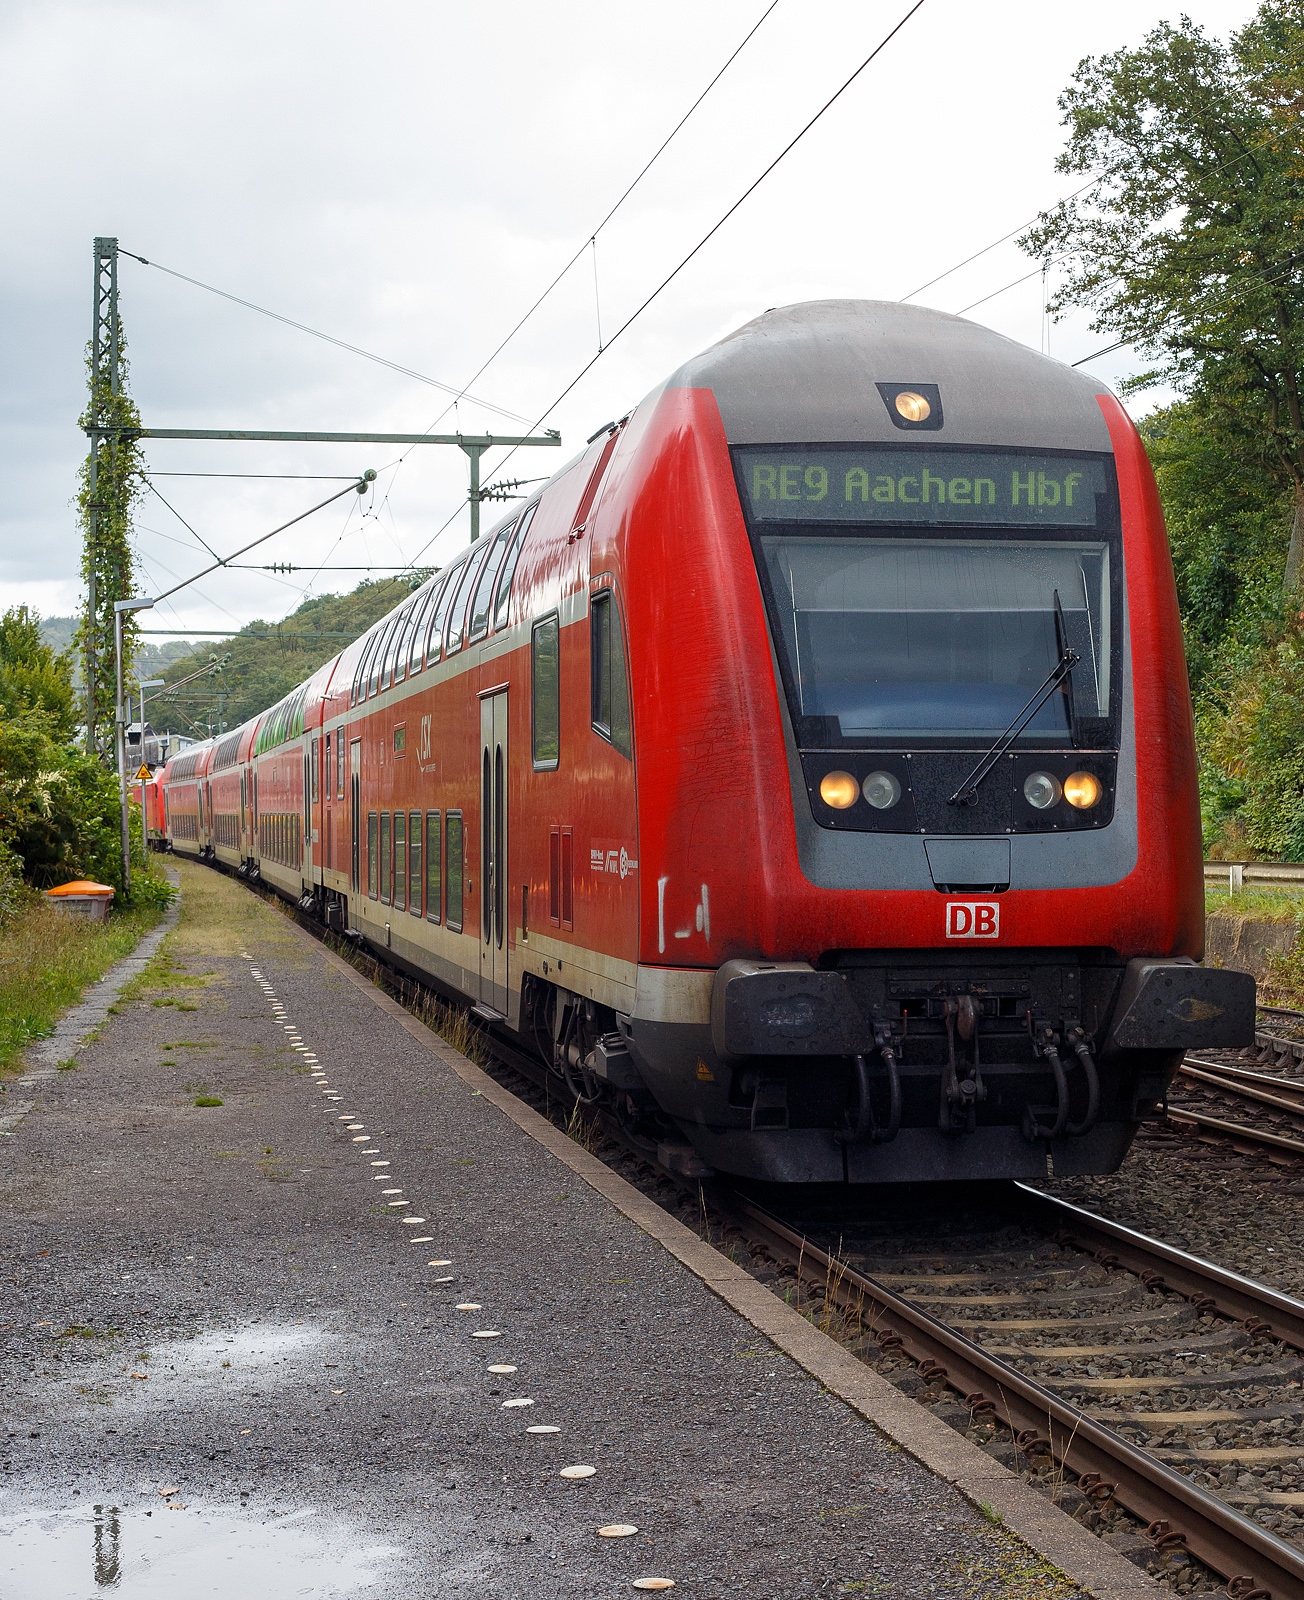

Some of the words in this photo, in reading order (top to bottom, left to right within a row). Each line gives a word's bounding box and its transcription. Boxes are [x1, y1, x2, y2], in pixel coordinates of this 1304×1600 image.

[752, 465, 828, 501] RE9
[845, 467, 996, 504] Aachen
[1011, 471, 1083, 506] Hbf
[950, 905, 997, 936] DB
